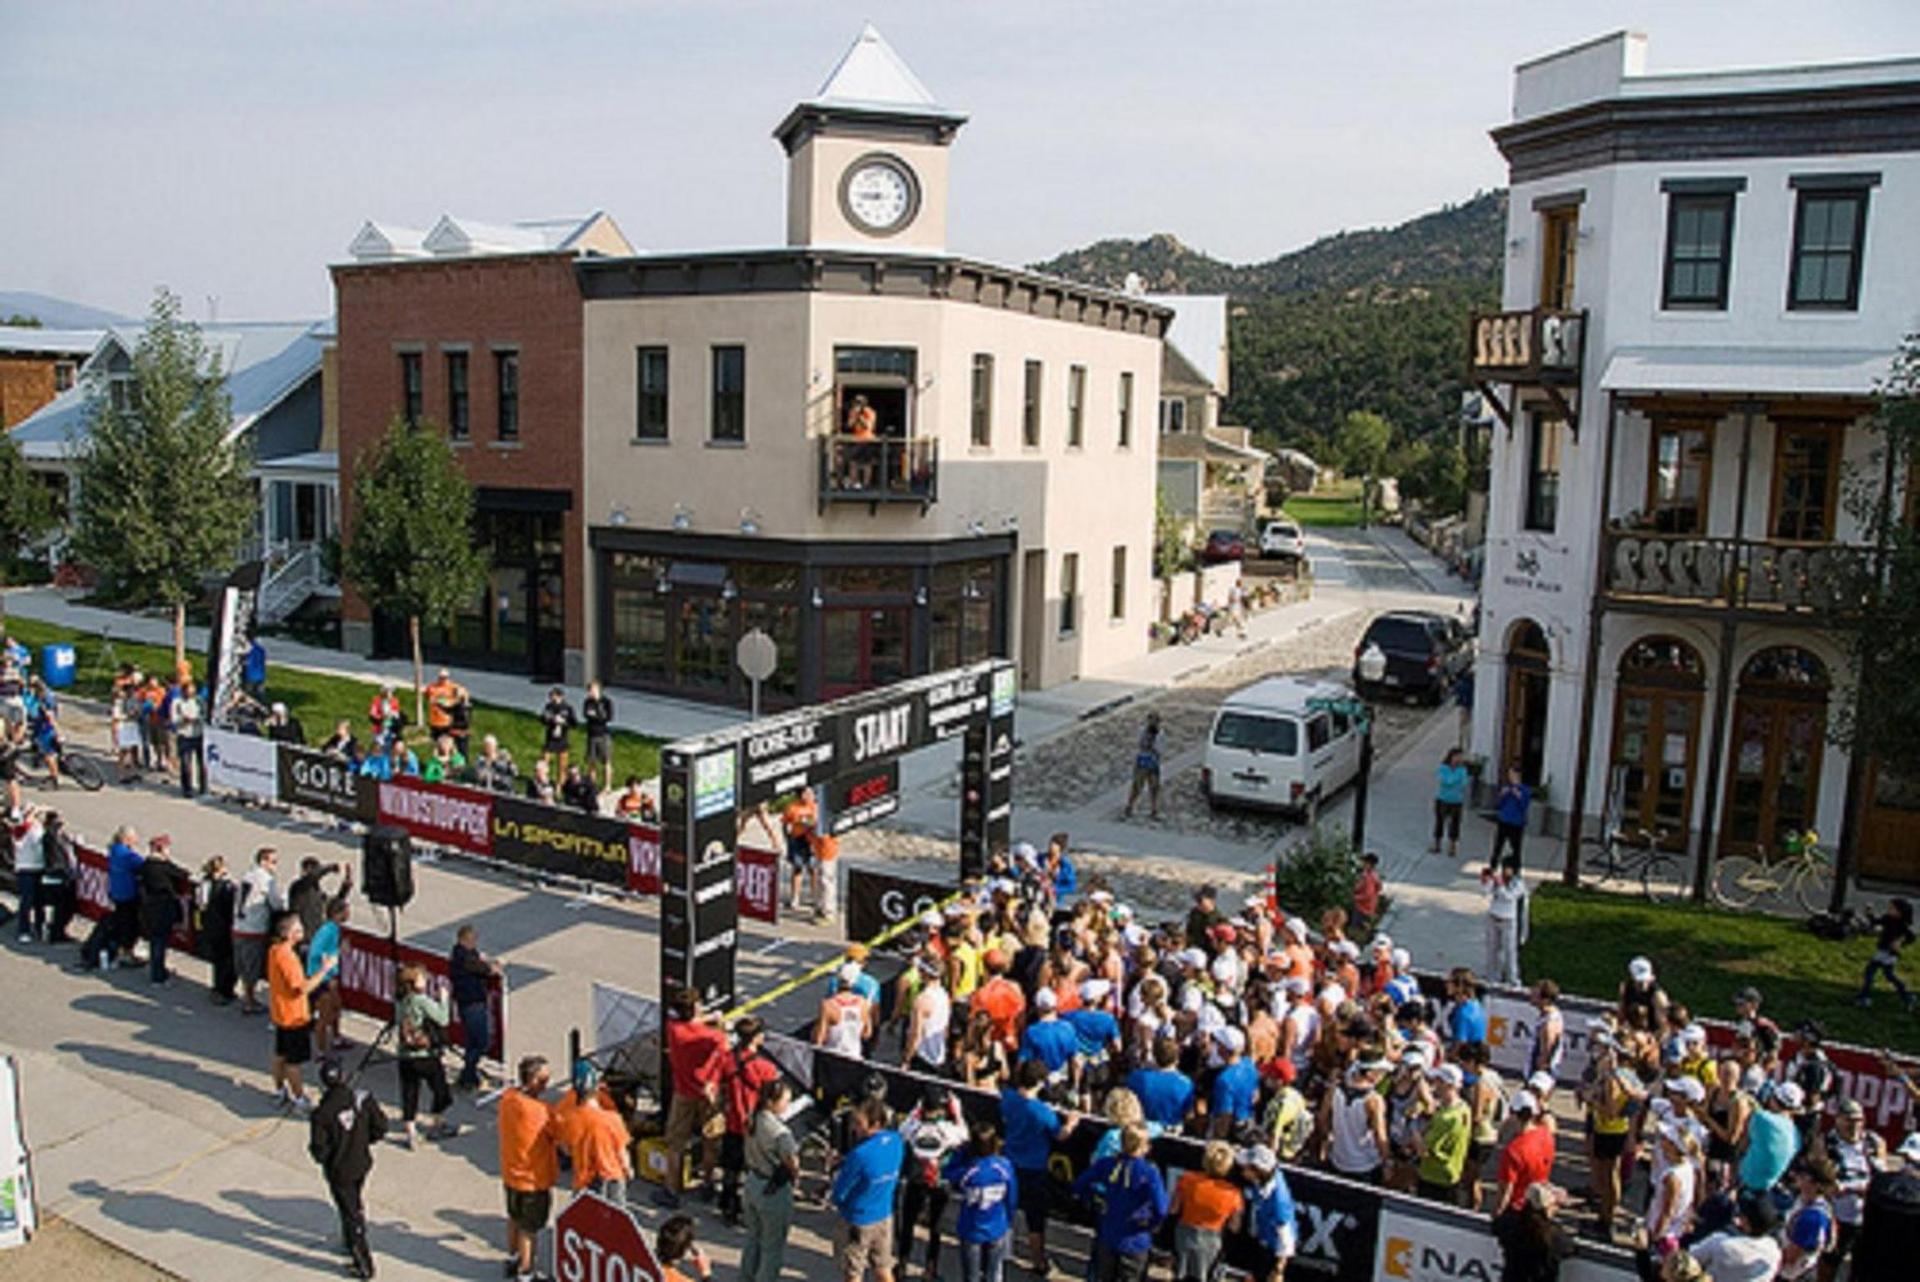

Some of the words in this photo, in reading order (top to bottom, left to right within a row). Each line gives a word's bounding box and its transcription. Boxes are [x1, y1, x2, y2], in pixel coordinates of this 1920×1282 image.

[854, 703, 911, 762] START
[292, 758, 357, 796] GORE
[379, 782, 491, 837] WINDSTOPPER
